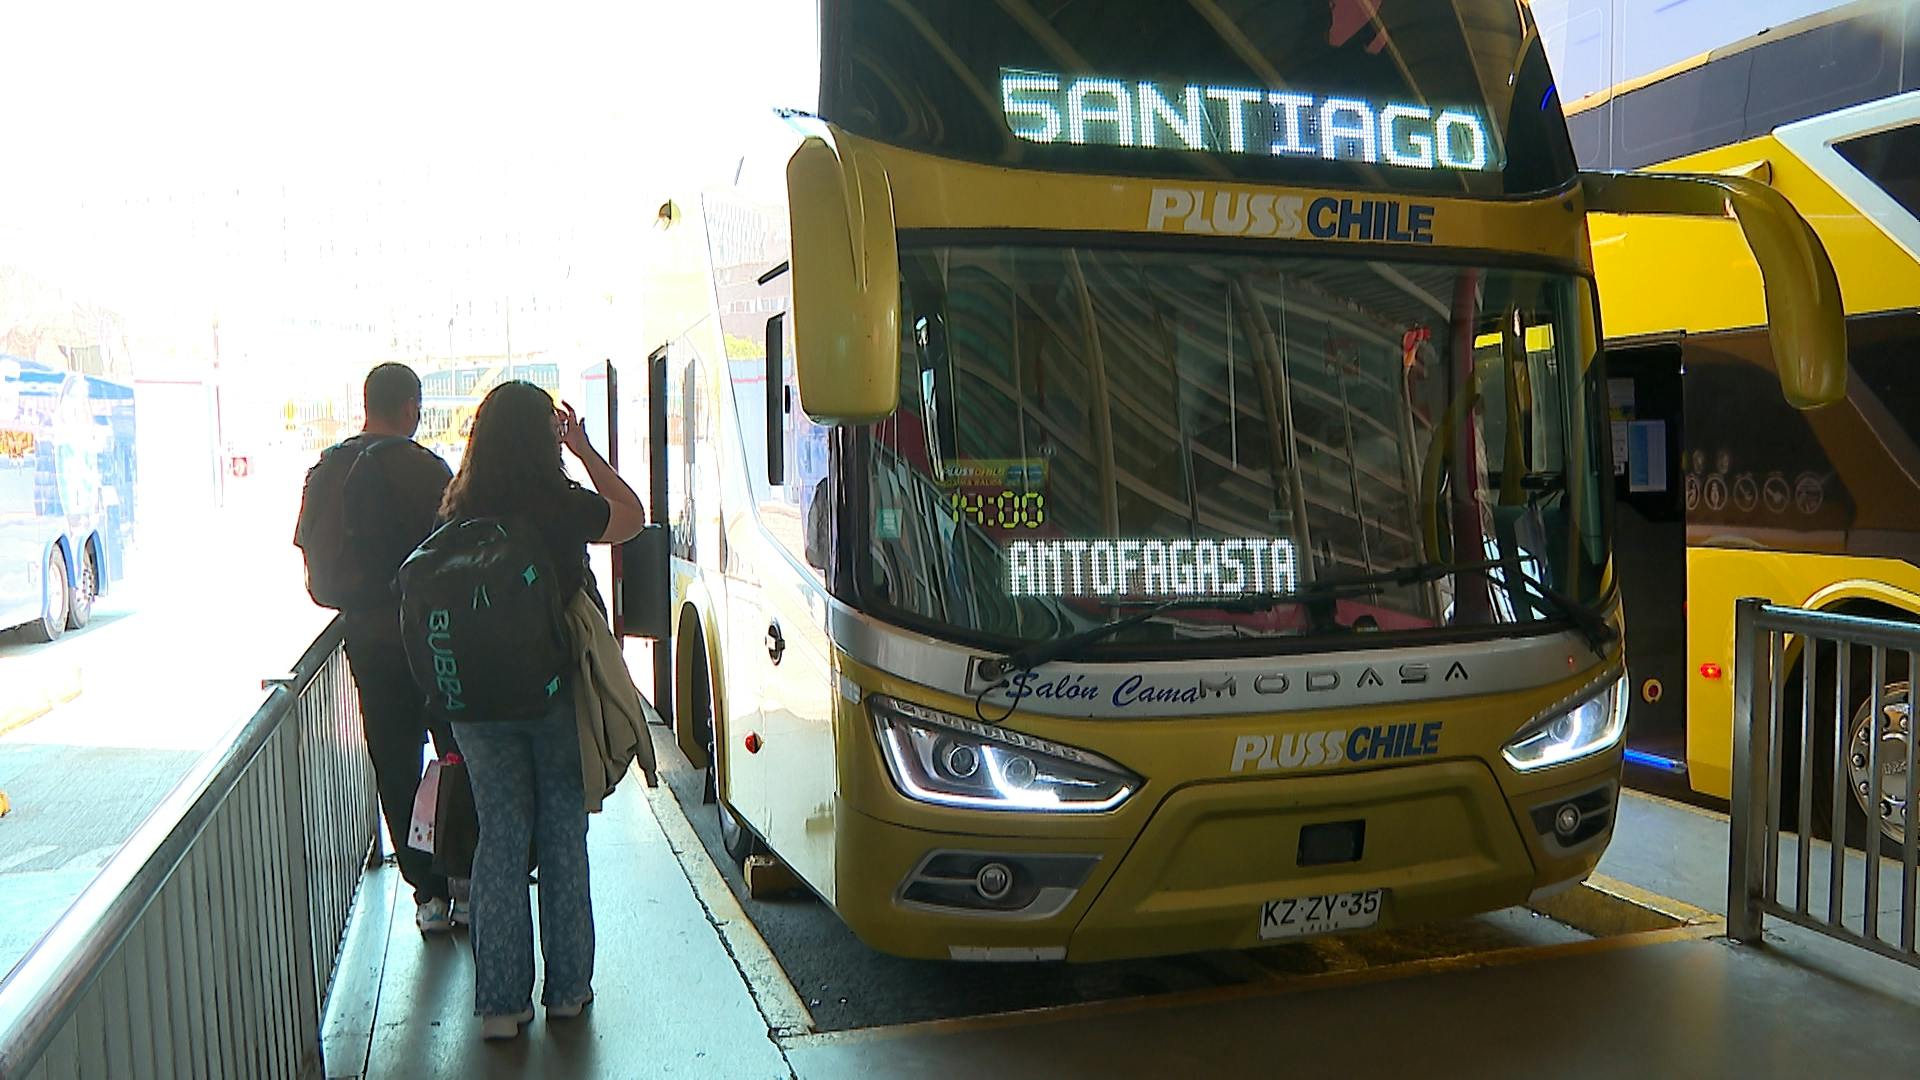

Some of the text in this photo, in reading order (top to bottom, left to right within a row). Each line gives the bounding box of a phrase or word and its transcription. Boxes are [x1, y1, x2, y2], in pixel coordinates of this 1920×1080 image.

[1002, 74, 1488, 170] SANTIAGO
[950, 489, 1044, 529] 14:00
[1008, 537, 1296, 597] ANTOFAGASTA
[426, 607, 466, 711] BUBBA
[1200, 660, 1469, 698] MODASA
[1005, 671, 1200, 708] Salón Cama
